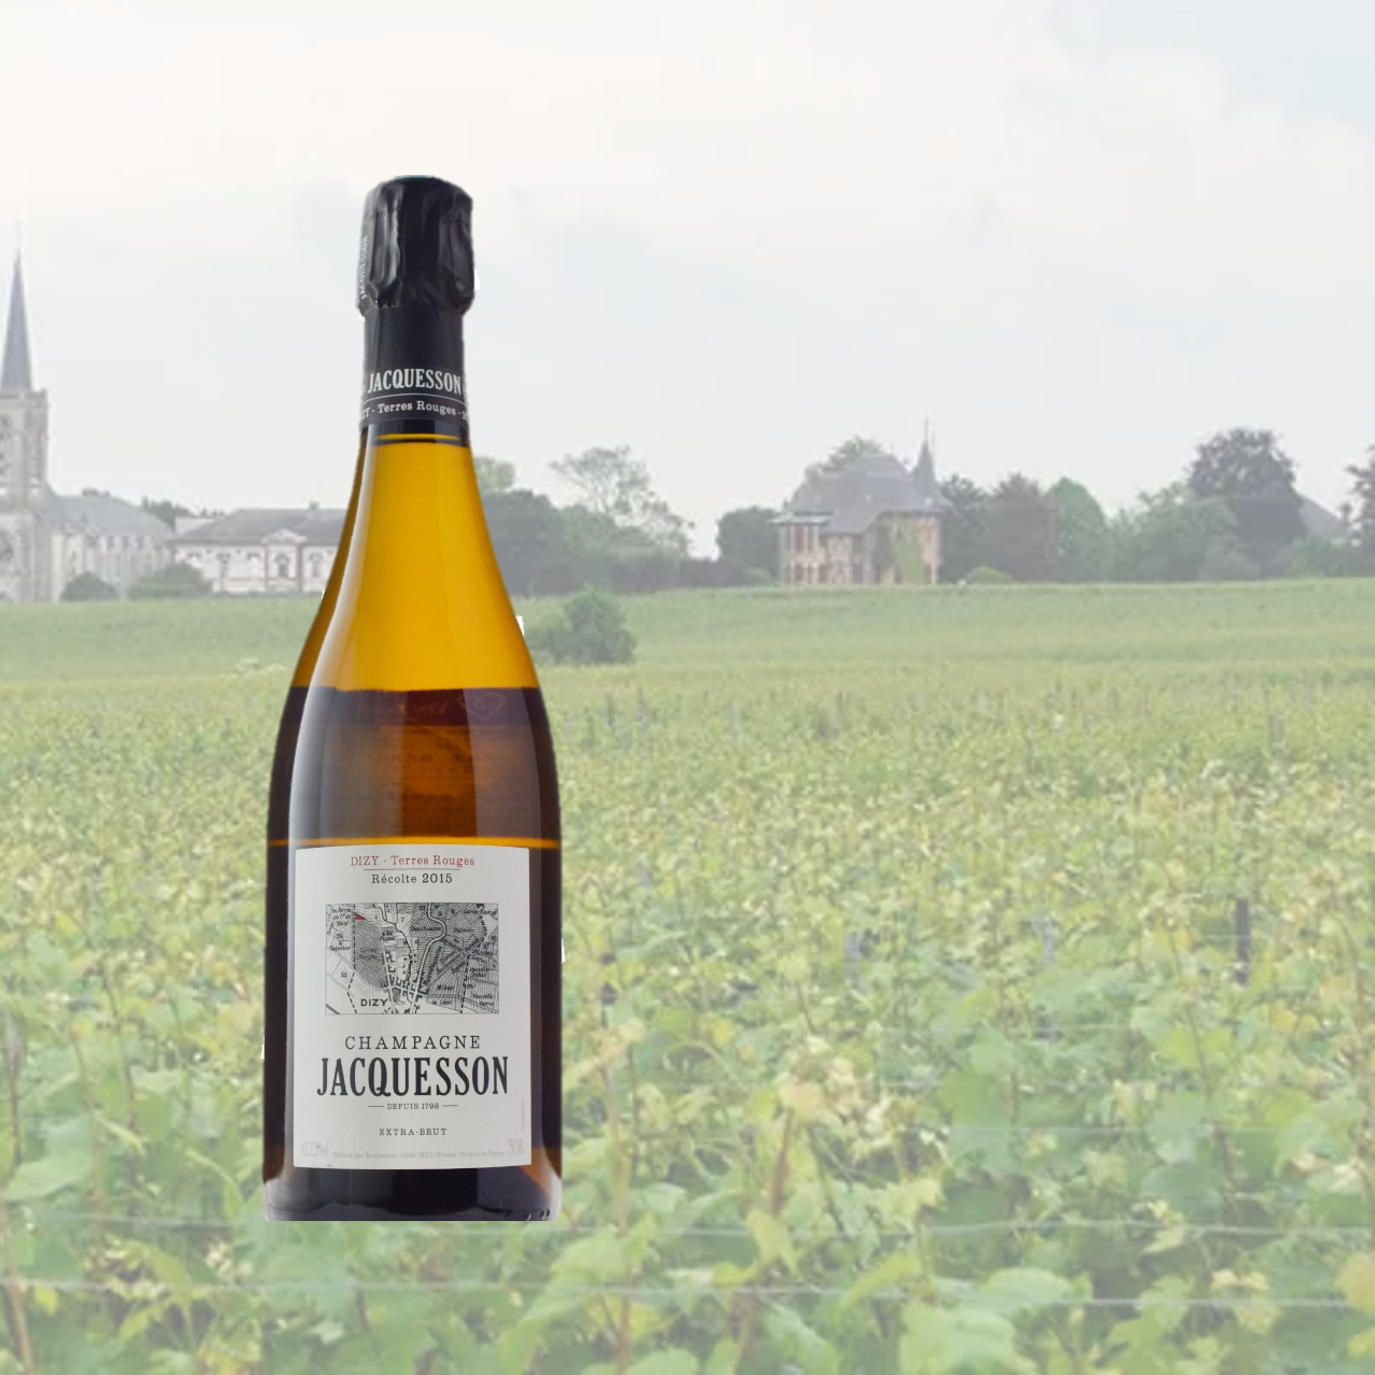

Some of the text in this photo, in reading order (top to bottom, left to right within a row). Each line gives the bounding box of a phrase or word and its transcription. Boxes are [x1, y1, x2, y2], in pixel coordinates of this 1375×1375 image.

[367, 368, 461, 395] JACQUESSON
[377, 402, 413, 414] Terres
[416, 400, 457, 416] Rouges
[350, 855, 379, 867] DIZY
[390, 854, 429, 866] Terres
[433, 854, 476, 868] Rouges
[371, 873, 453, 884] Récolte 2015
[360, 998, 389, 1007] DIZY
[344, 1035, 481, 1051] CHAMPAGNE
[316, 1056, 509, 1098] JACQUESSON
[421, 1102, 440, 1110] 1798
[378, 1128, 447, 1136] EXTRA-BRUT
